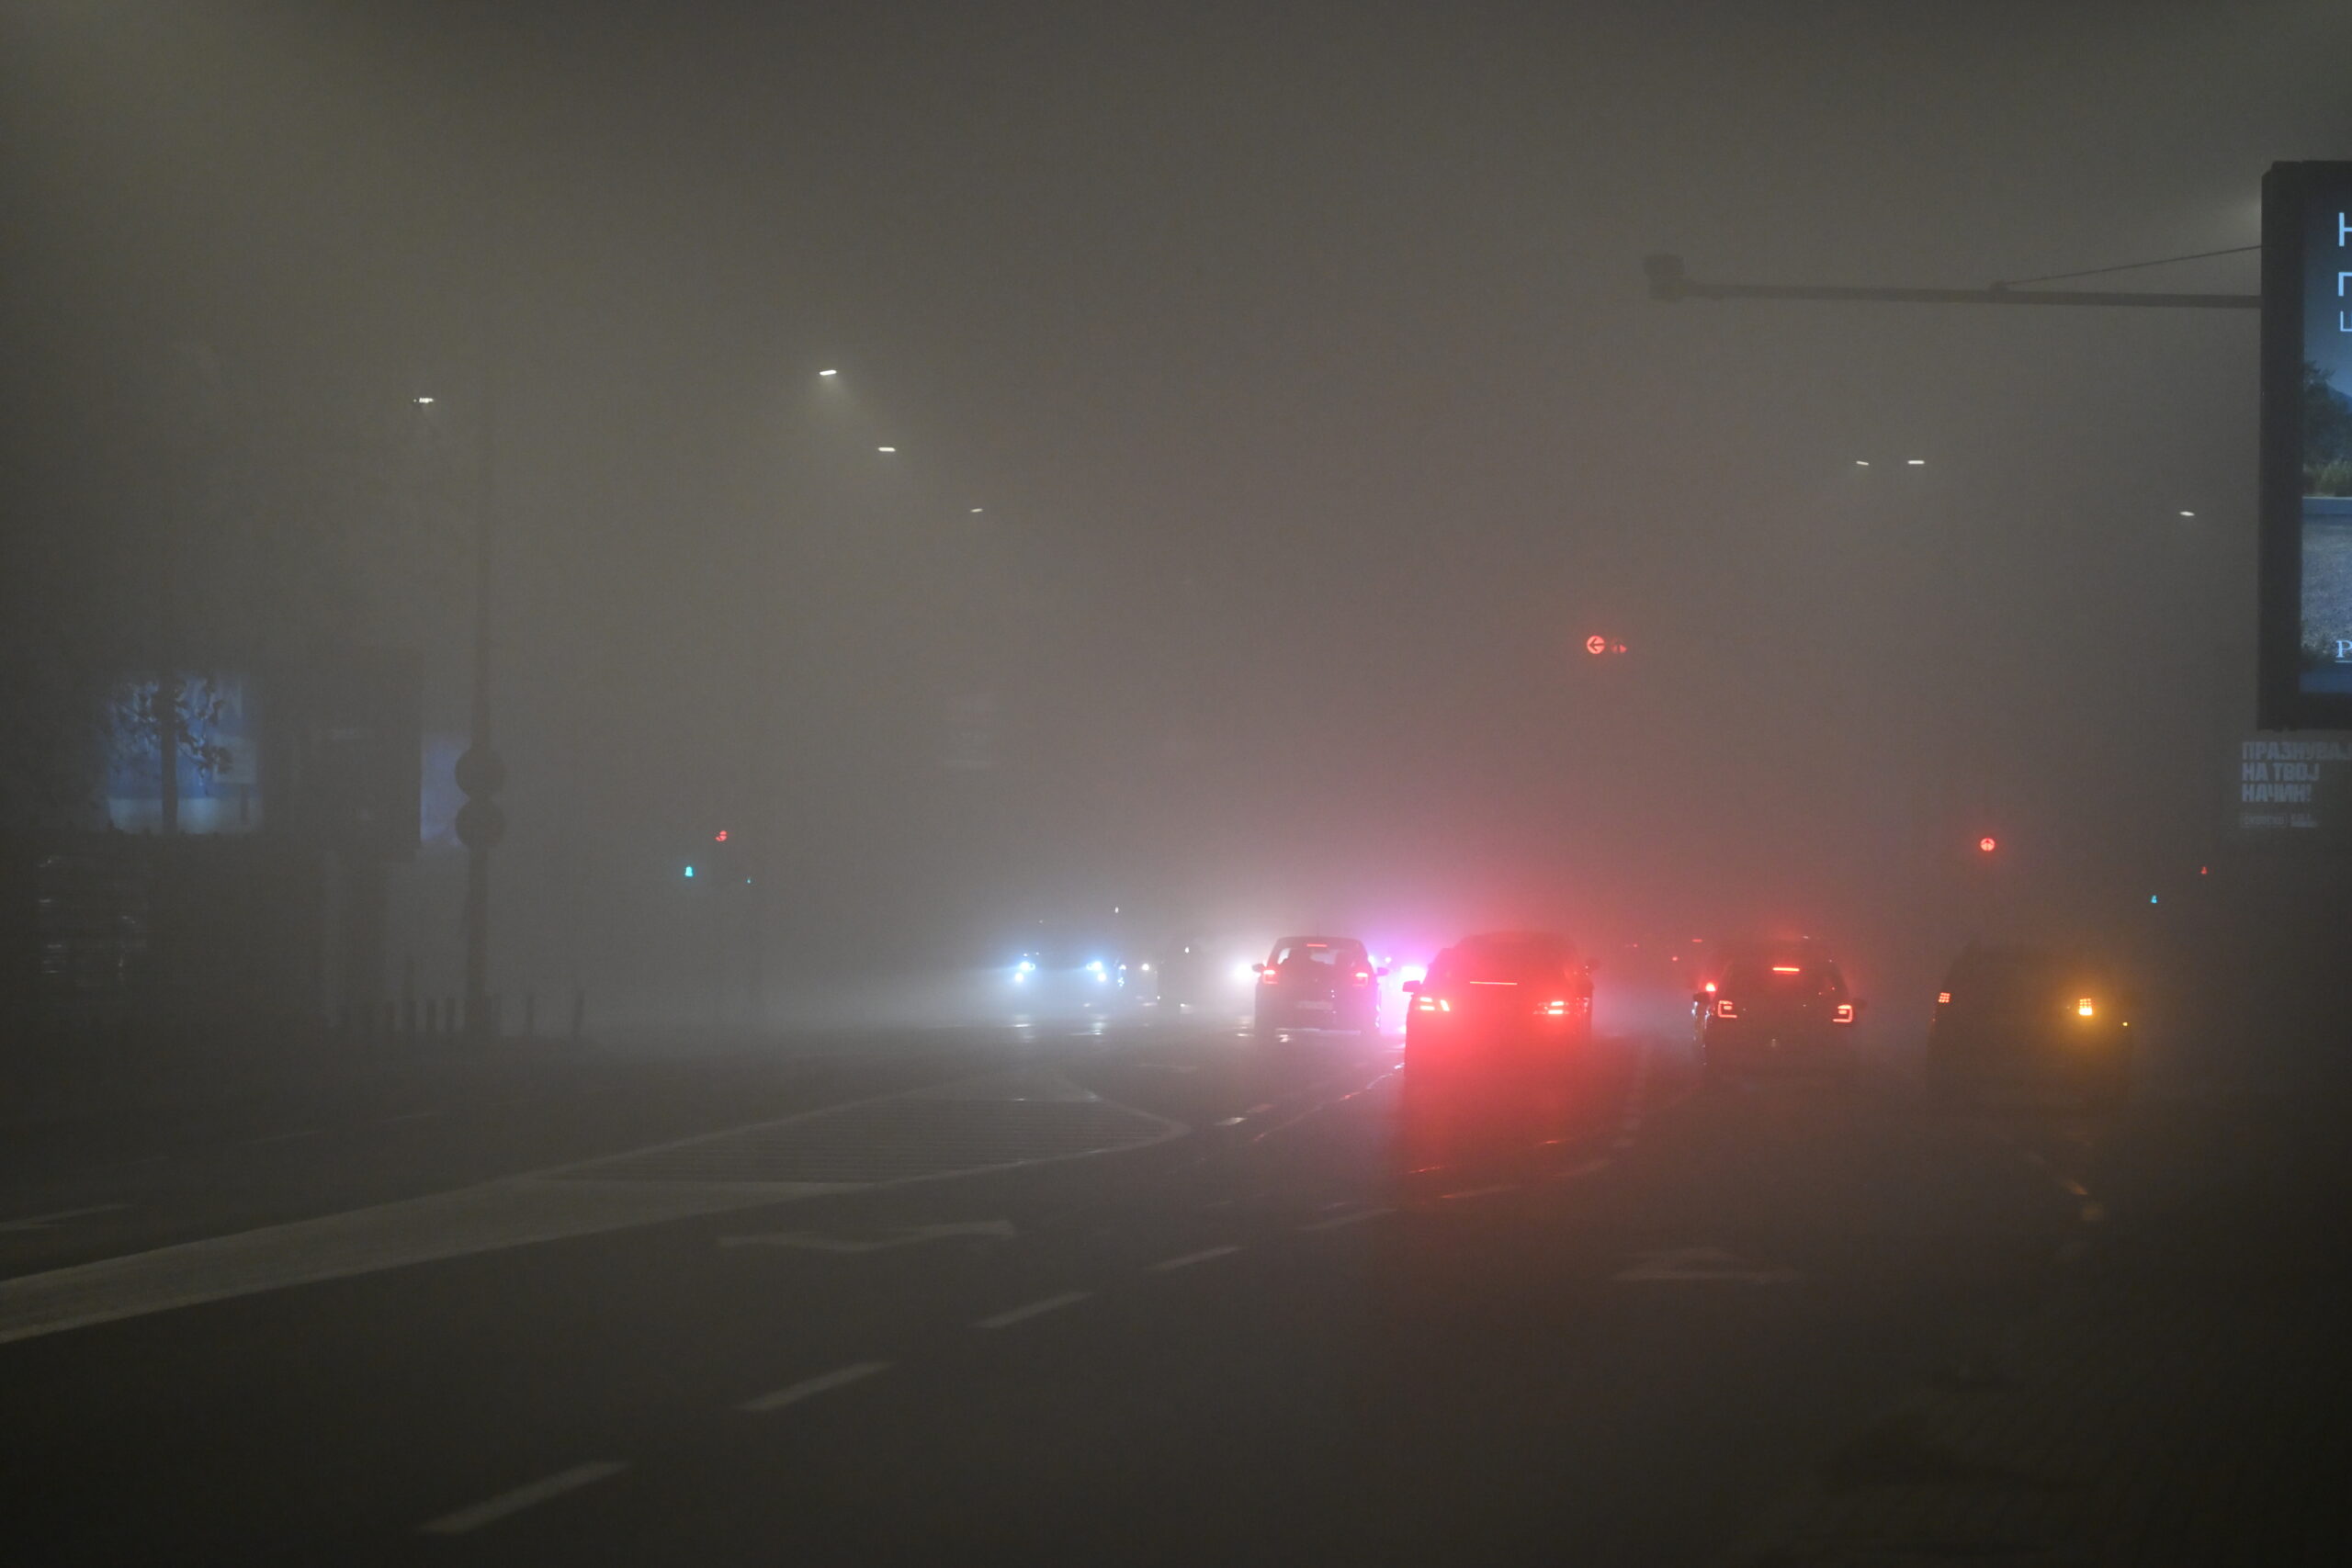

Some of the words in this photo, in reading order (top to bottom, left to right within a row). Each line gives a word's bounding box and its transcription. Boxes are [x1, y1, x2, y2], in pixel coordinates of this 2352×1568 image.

[2242, 762, 2268, 782] НА
[2272, 762, 2320, 782] ТВОЈ
[2242, 783, 2312, 803] НАЧИН!
